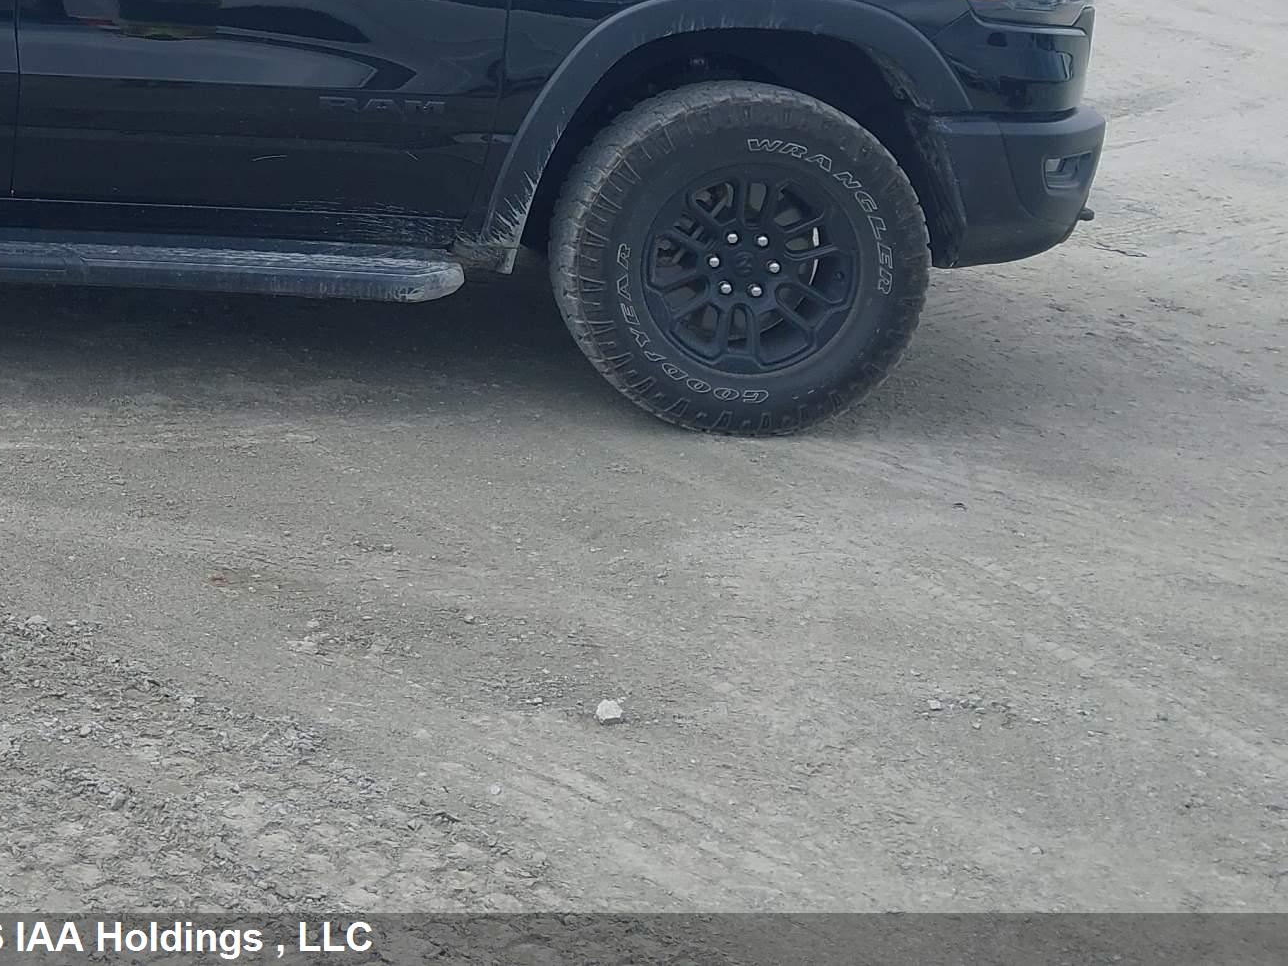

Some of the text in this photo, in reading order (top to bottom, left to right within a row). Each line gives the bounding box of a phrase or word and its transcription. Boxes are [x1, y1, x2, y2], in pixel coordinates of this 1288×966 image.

[319, 96, 446, 123] RAM
[748, 139, 893, 295] WRANGLER
[617, 243, 769, 403] GOODYEAR
